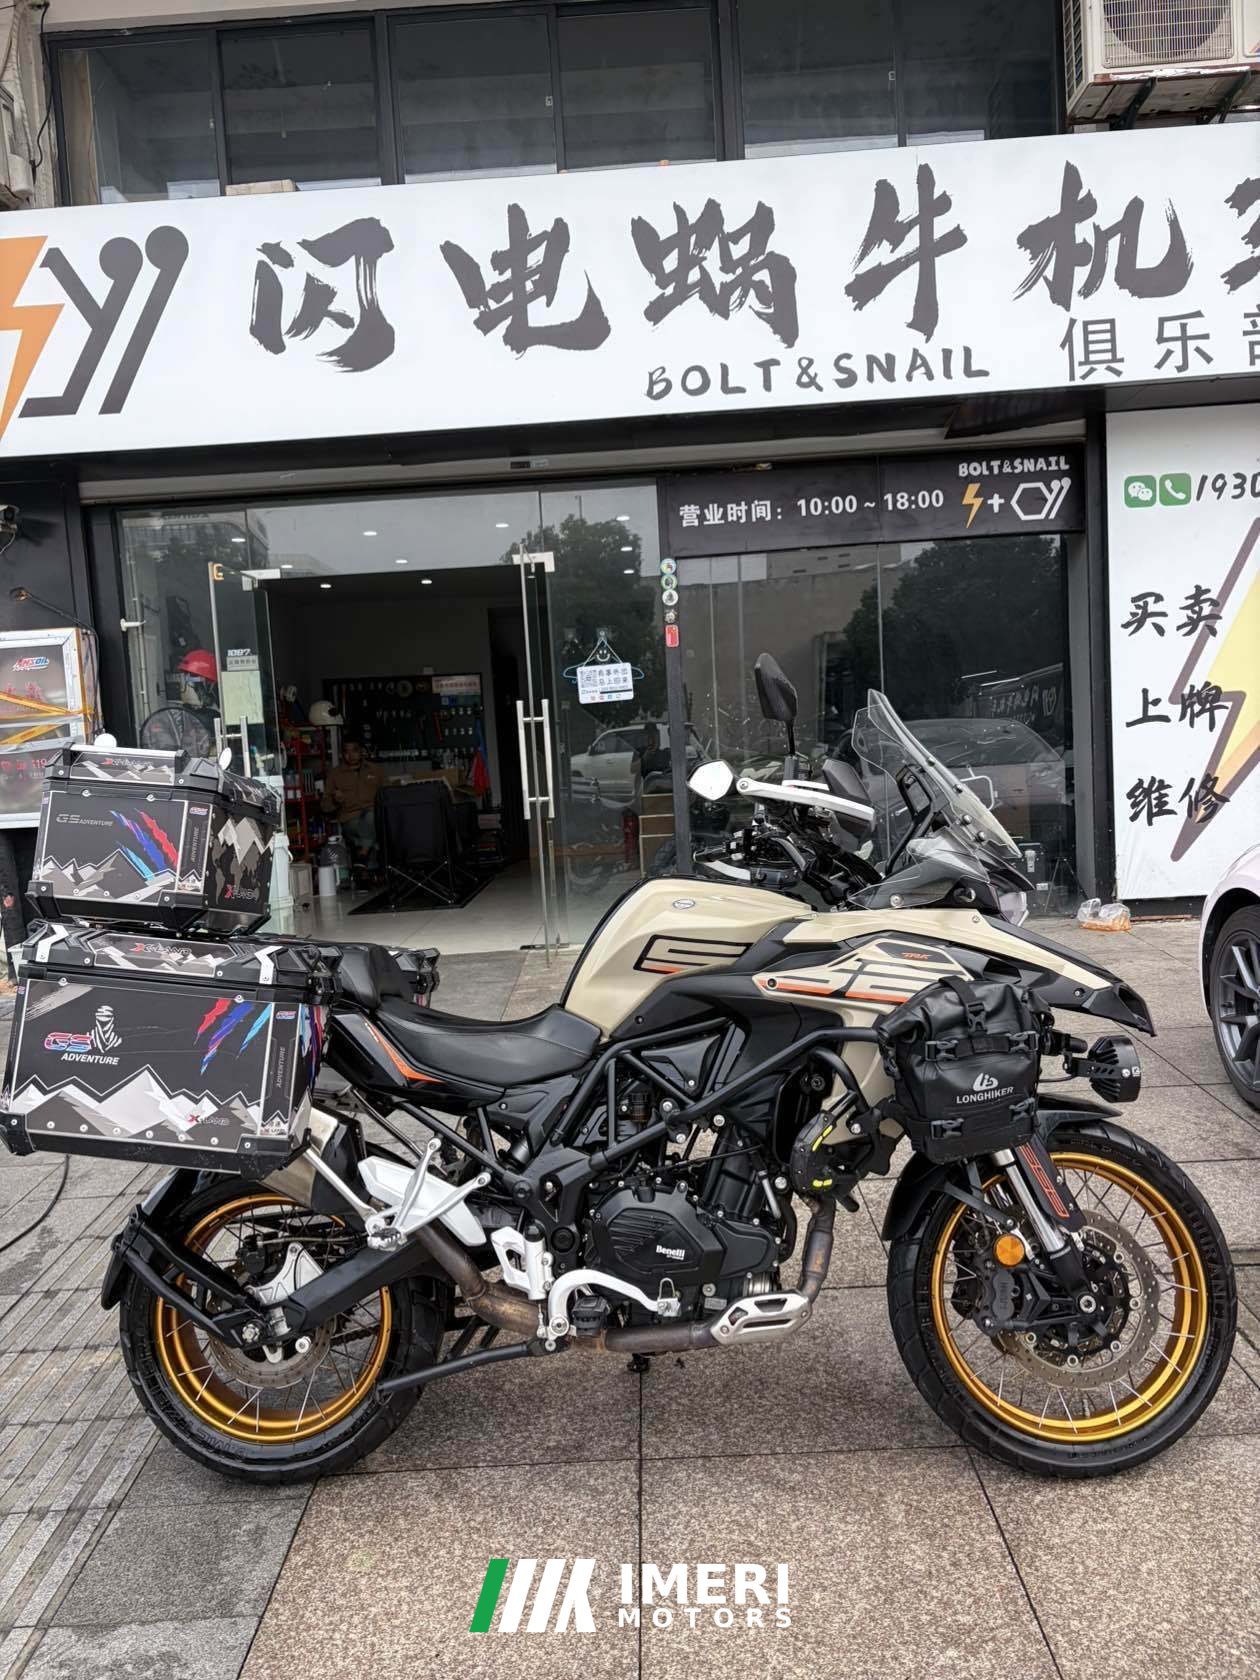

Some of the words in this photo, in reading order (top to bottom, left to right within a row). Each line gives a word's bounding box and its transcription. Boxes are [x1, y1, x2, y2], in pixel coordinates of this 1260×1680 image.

[646, 345, 990, 401] BOLT&SNAIL
[958, 455, 1070, 478] BOLT&SNAIL
[797, 494, 858, 518] 10:00
[884, 489, 944, 512] 18:00
[1121, 584, 1222, 638] 买卖
[1125, 680, 1230, 733] 上牌
[1125, 773, 1231, 826] 维修
[44, 1032, 92, 1053] GS
[61, 1053, 120, 1065] ADVENTURE
[956, 1086, 1015, 1104] LONGHIKER
[656, 1244, 685, 1257] Benelli
